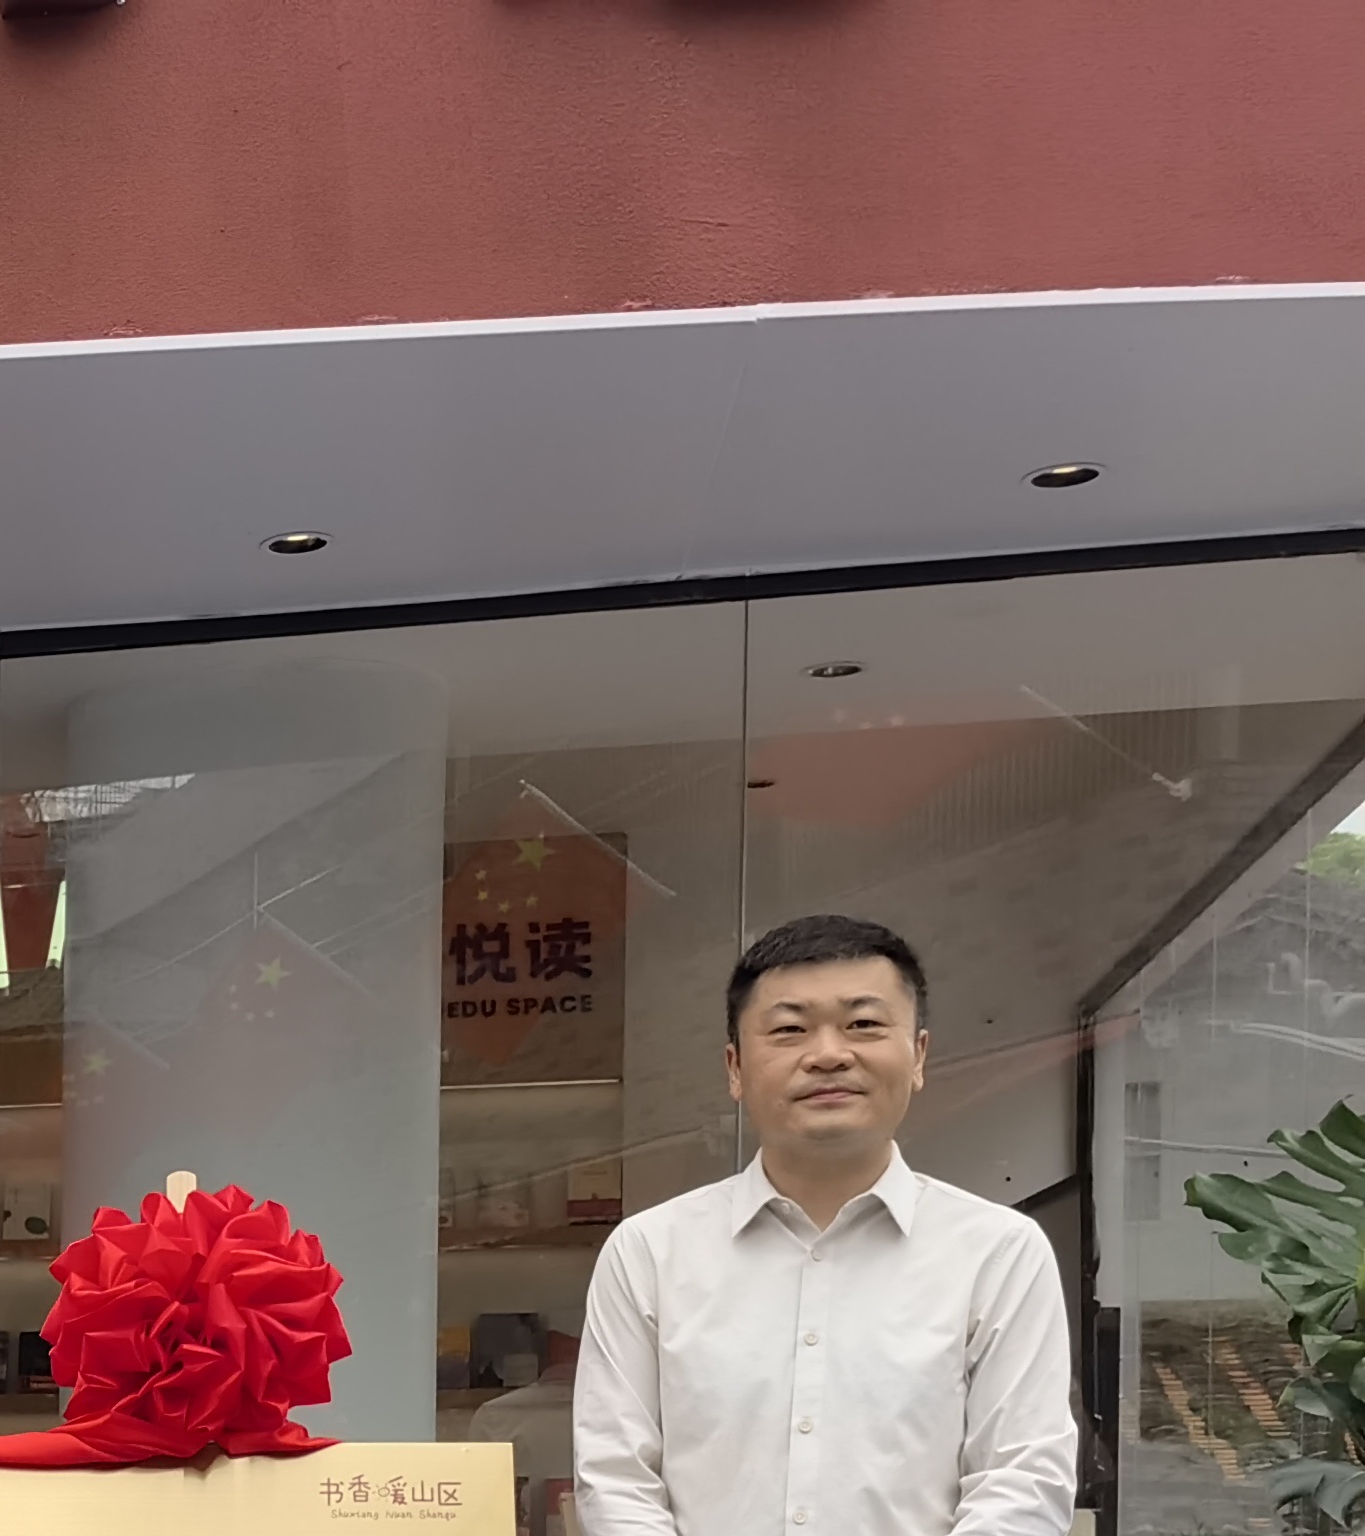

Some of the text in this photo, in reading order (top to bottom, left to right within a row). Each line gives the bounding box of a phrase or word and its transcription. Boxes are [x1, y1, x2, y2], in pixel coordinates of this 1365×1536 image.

[448, 917, 593, 986] 悦读
[506, 994, 593, 1016] SPACE
[319, 1474, 463, 1506] 书香暖山区
